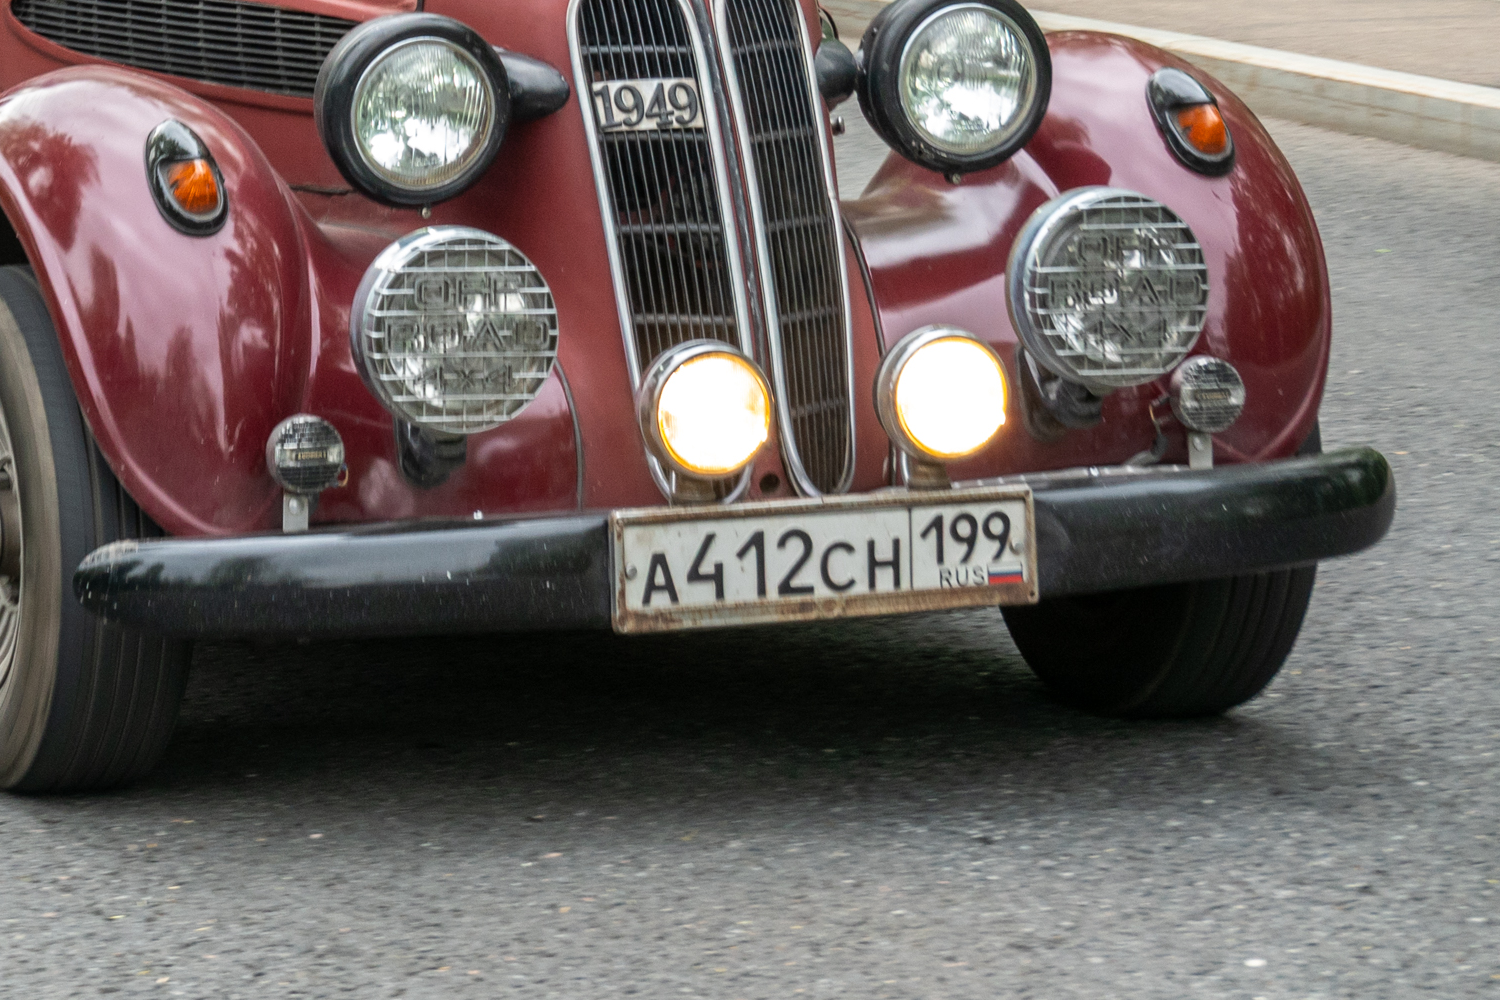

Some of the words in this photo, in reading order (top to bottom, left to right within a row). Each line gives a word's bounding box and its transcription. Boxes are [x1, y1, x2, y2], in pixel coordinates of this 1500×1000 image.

[594, 82, 698, 129] 1949
[414, 272, 522, 311] OFF
[1050, 274, 1201, 311] ROAD
[386, 315, 549, 354] ROAD
[920, 511, 1012, 565] 199
[939, 564, 986, 589] RUS
